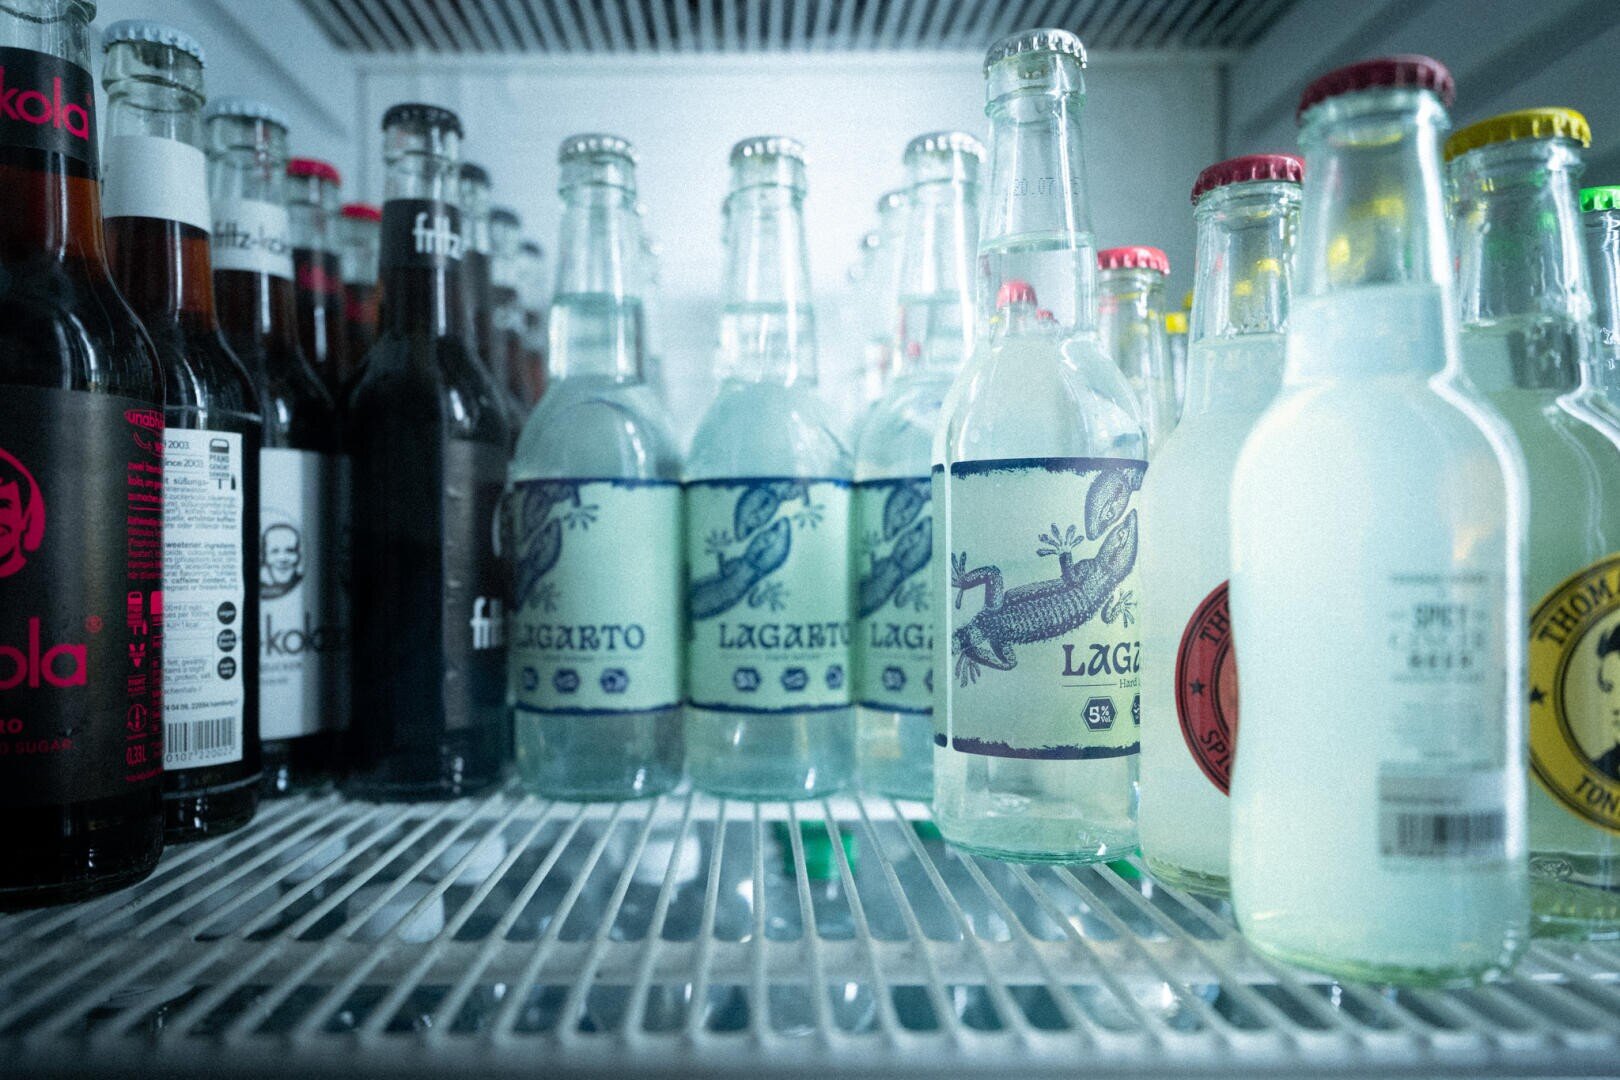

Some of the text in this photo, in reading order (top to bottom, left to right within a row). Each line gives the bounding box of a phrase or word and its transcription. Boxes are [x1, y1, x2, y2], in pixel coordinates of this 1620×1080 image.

[1538, 565, 1620, 645] THOM
[513, 623, 646, 650] AGARTO
[1575, 775, 1620, 818] TON
